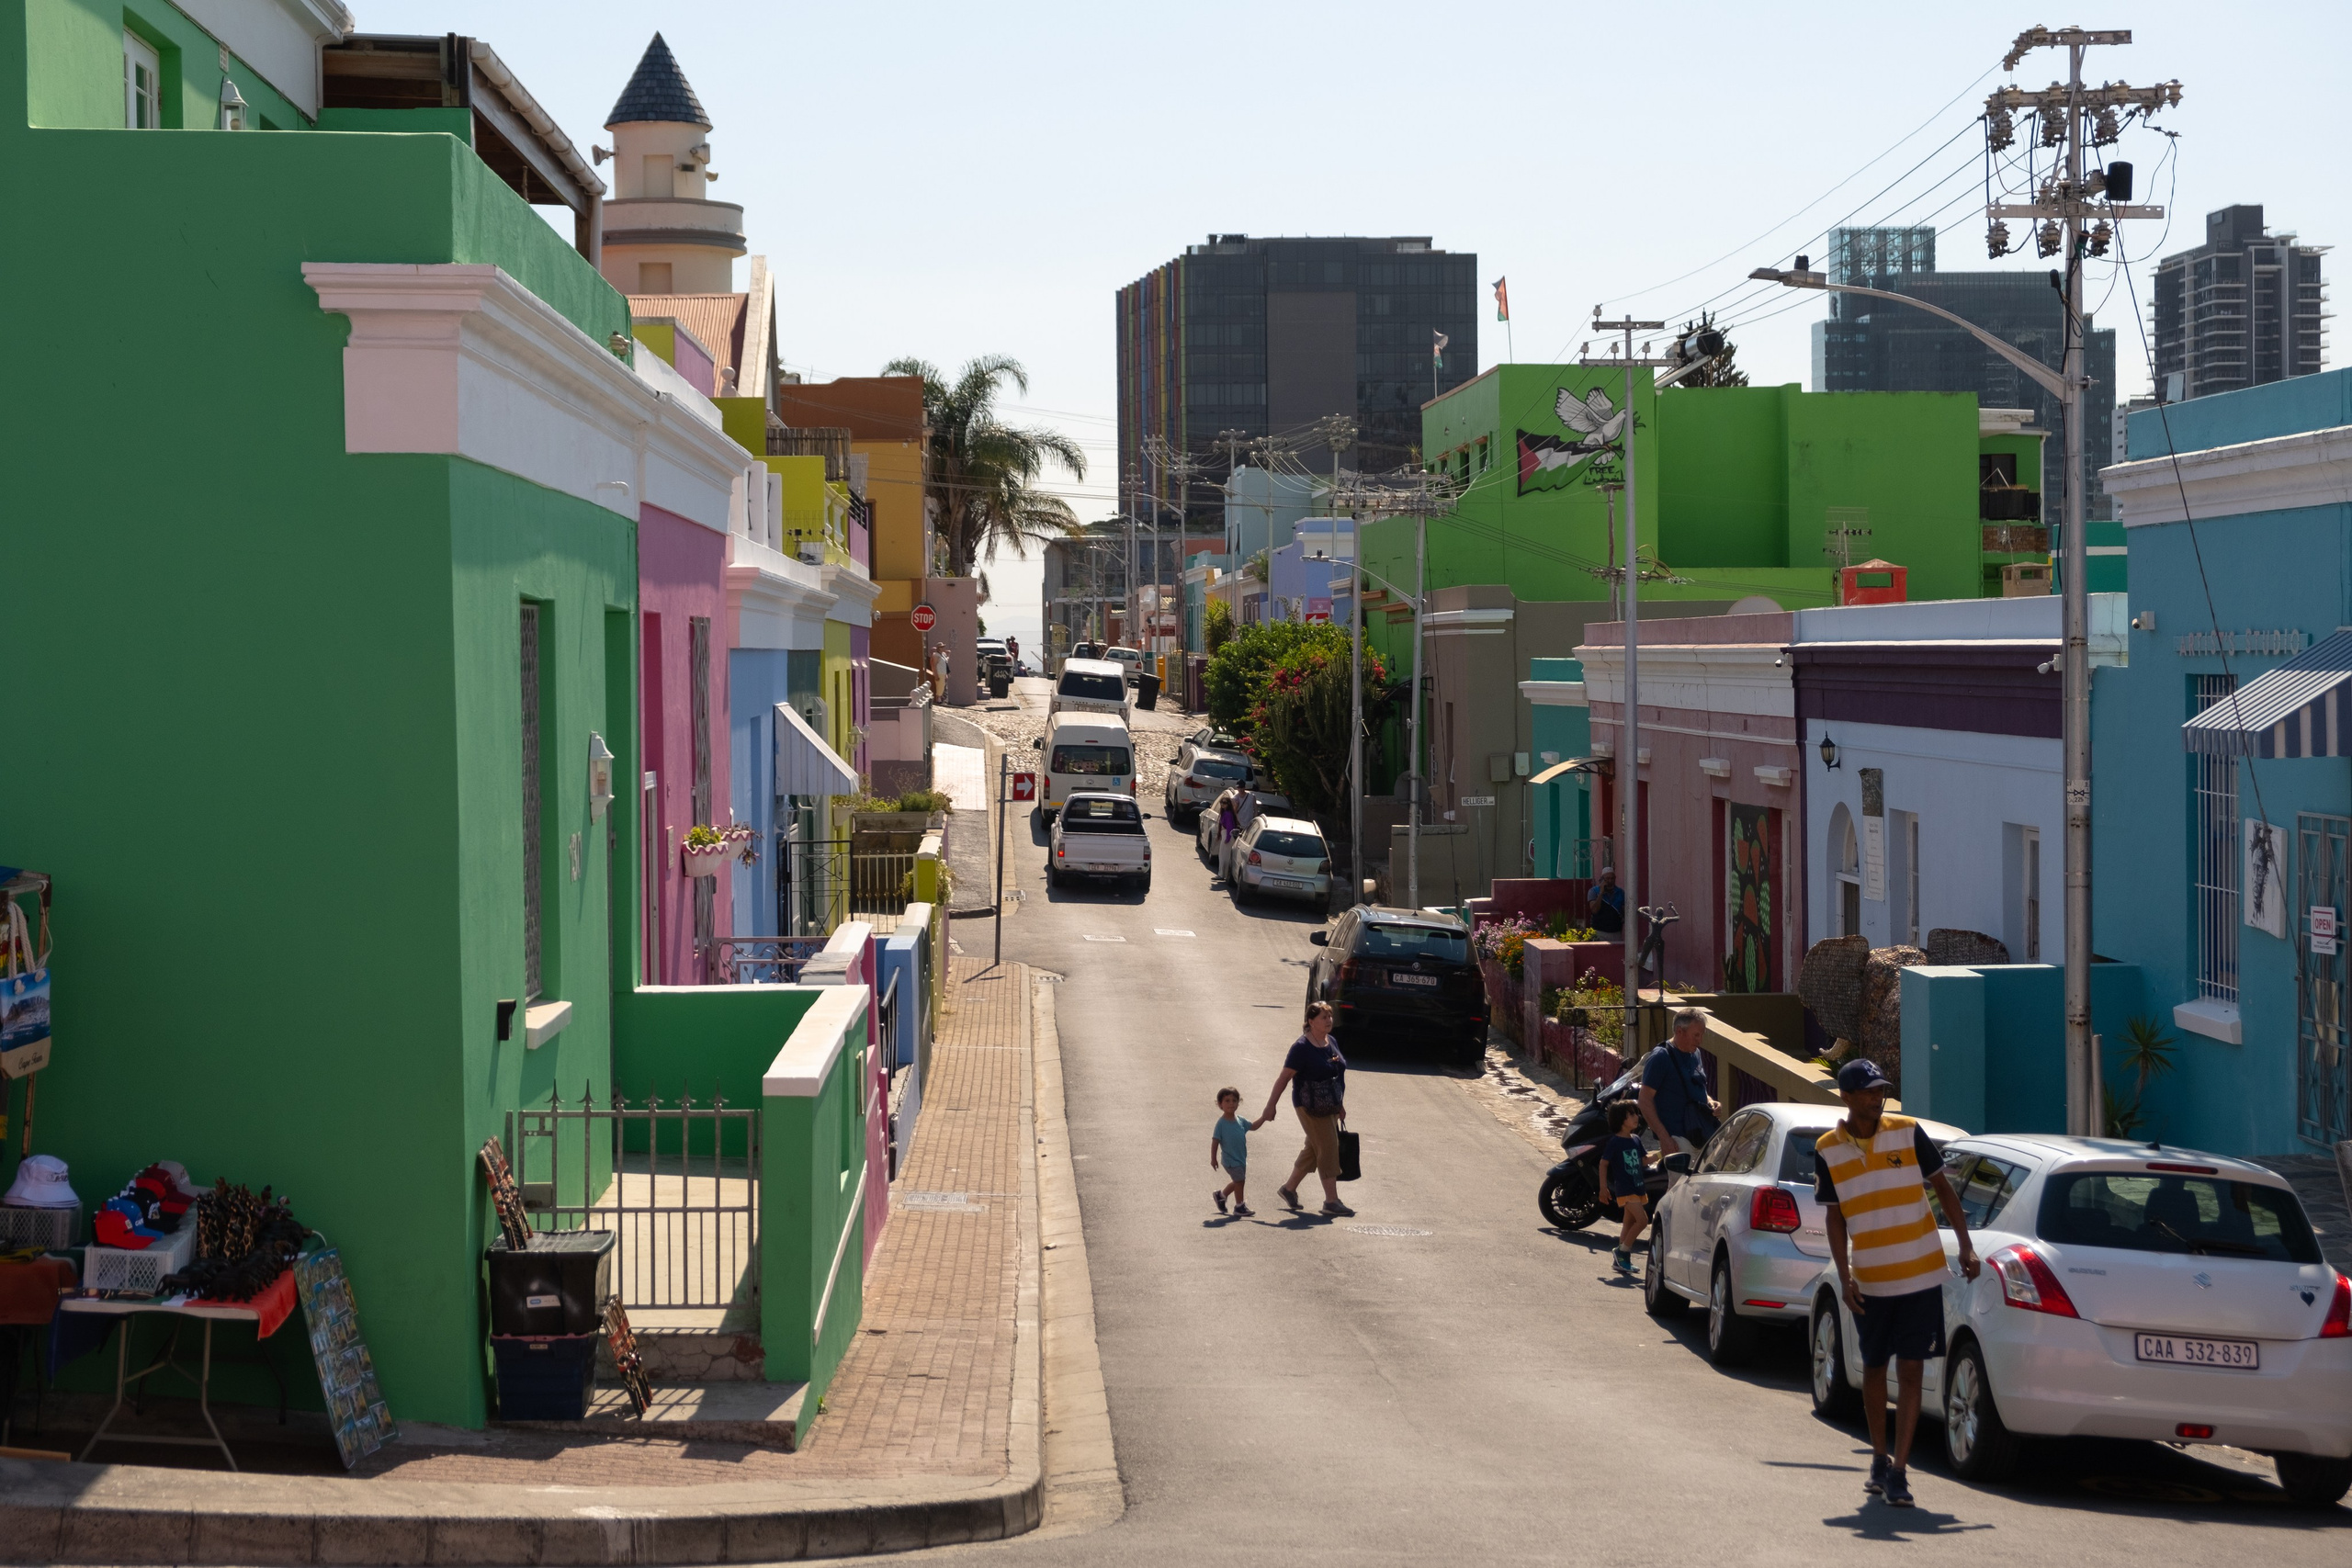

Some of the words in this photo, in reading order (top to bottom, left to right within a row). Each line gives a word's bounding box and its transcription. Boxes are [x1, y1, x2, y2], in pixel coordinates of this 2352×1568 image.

[1589, 466, 1615, 475] FREE
[913, 613, 933, 624] STOP
[2179, 629, 2235, 657] ARTIST'S
[2245, 627, 2300, 656] STUDIO
[1463, 797, 1487, 806] HELLIGER
[2314, 918, 2331, 931] OPEN
[1395, 974, 1404, 982] CA
[2143, 1337, 2174, 1359] CAA
[2185, 1340, 2252, 1365] 532-839
